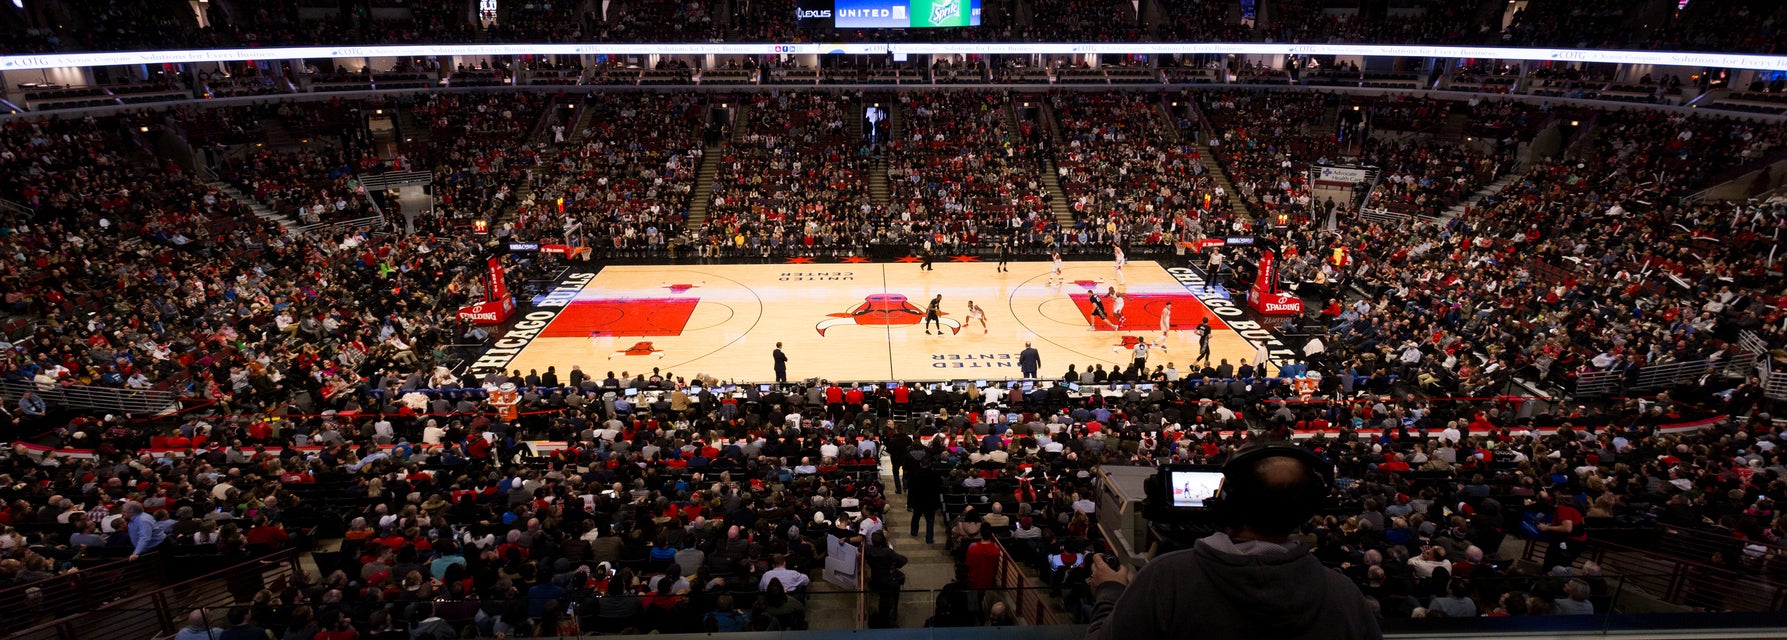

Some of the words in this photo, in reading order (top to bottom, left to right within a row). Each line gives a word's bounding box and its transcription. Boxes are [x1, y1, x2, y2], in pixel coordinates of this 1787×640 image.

[840, 9, 890, 17] UNITED
[933, 3, 957, 22] Sprite
[1559, 51, 1585, 59] COTG
[14, 56, 48, 66] COTG
[537, 272, 595, 307] BULLS
[1167, 267, 1242, 316] CHICAGO
[1266, 303, 1300, 312] SPALDING
[460, 312, 496, 320] SPALDING
